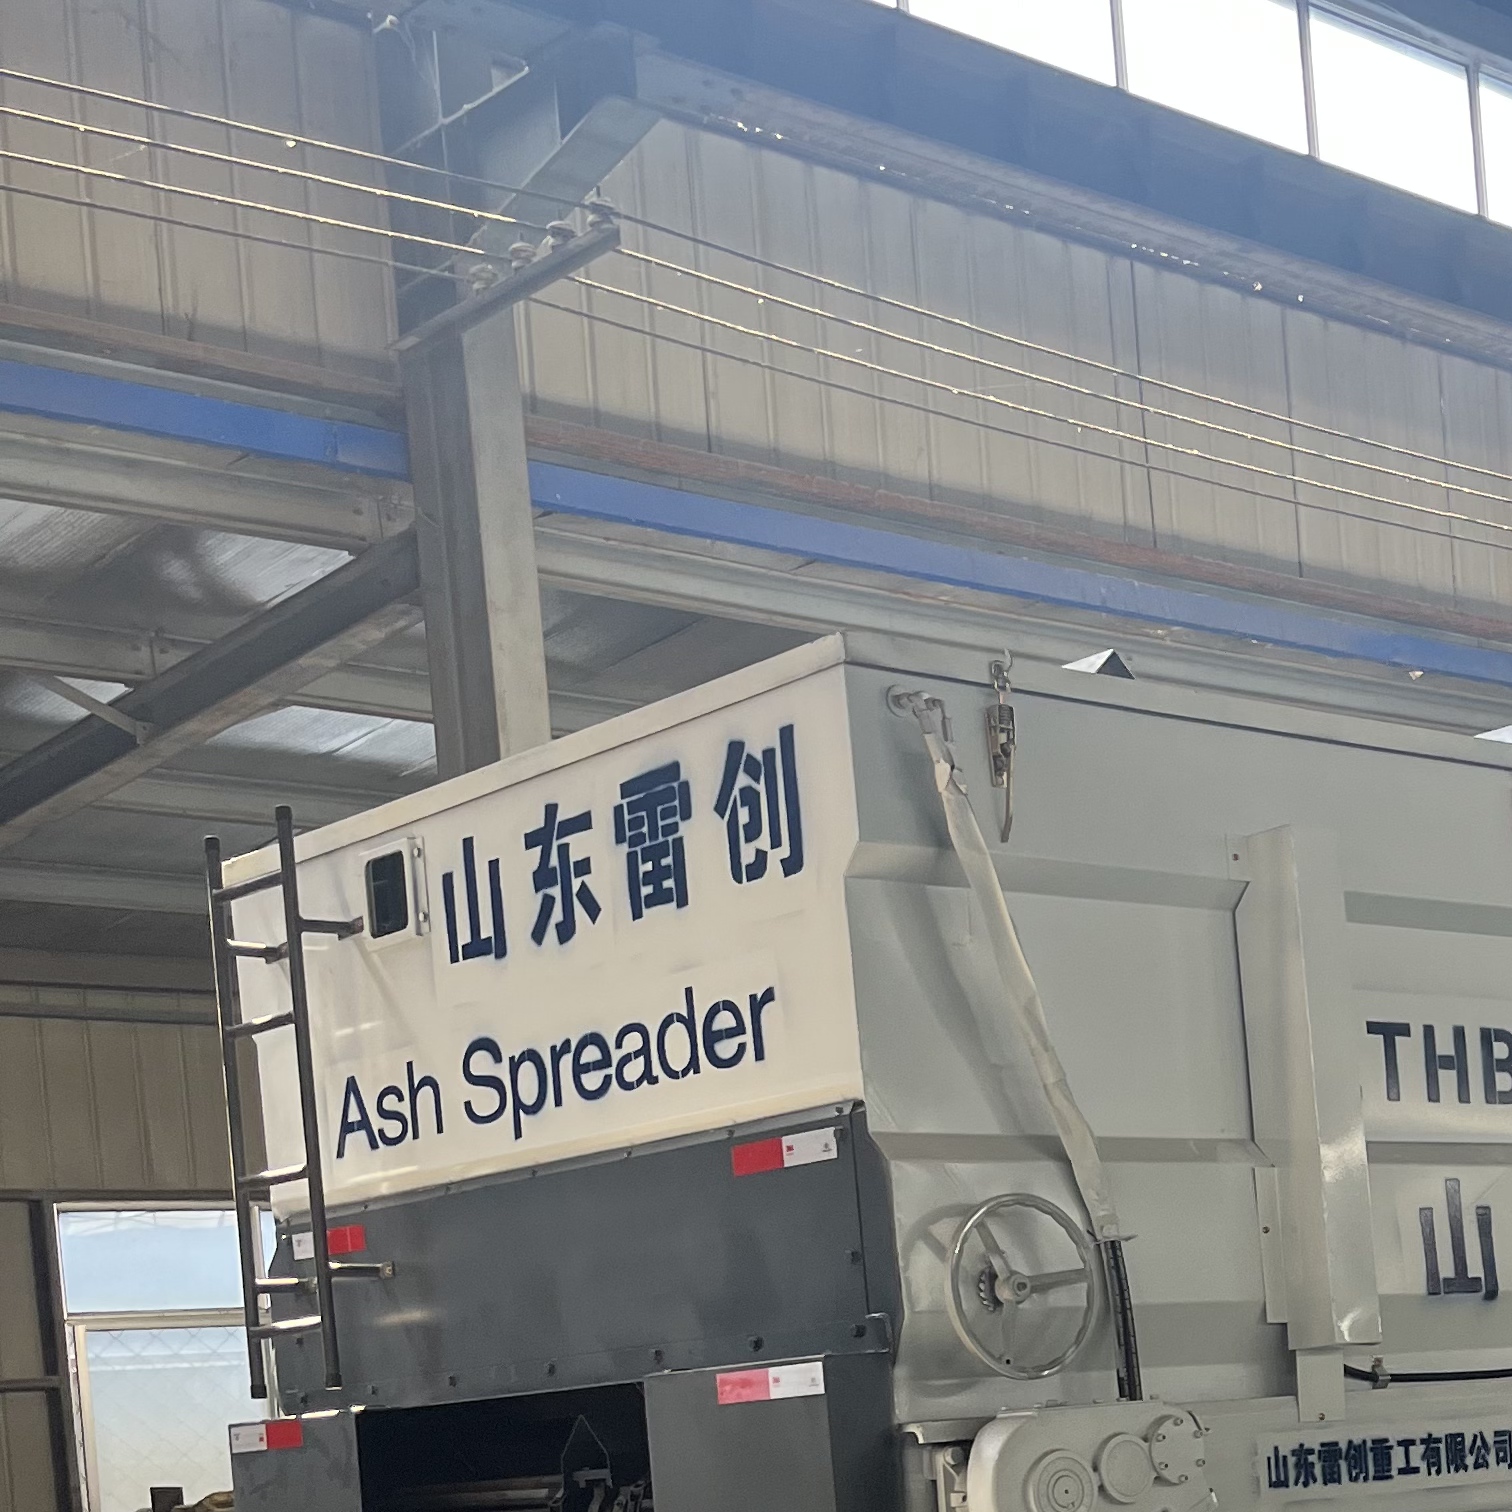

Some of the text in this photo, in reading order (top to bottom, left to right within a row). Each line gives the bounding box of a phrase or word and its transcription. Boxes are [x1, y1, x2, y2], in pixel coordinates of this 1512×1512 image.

[442, 724, 805, 965] 山东雷创
[336, 986, 774, 1159] Ash Spreader
